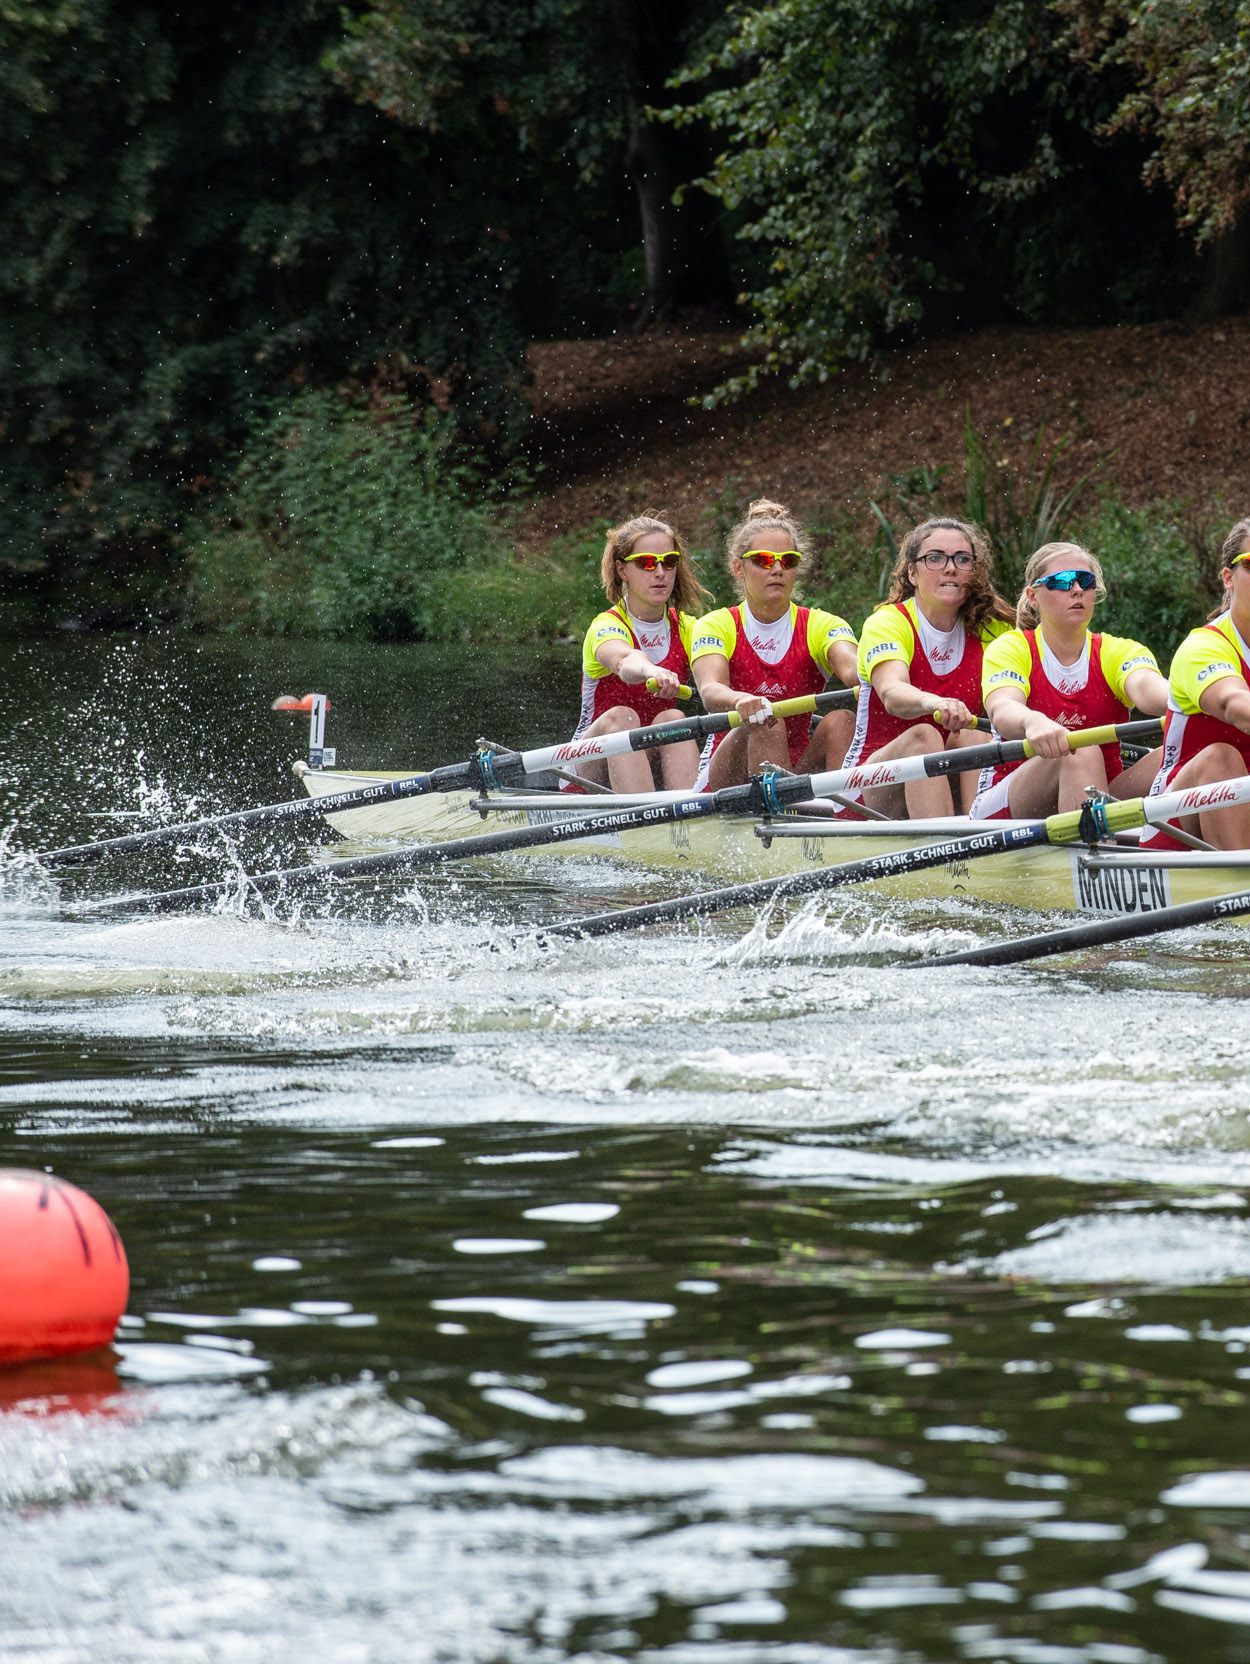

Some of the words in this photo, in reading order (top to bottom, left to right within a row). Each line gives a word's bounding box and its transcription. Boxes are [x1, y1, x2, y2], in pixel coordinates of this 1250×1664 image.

[699, 637, 723, 649] RBL
[872, 642, 898, 655] RBL
[313, 699, 321, 744] 1
[551, 740, 605, 765] Melitta
[843, 765, 900, 792] Melitta
[363, 786, 387, 799] GUT.
[1176, 783, 1240, 813] Melitta
[681, 801, 702, 812] RBL
[552, 823, 589, 836] STARK.
[591, 814, 642, 830] SCHNELL.
[643, 807, 669, 820] GUT.
[1011, 827, 1034, 840] RBL
[871, 854, 912, 870] STARK.
[914, 842, 969, 862] SCHNELL.
[970, 835, 998, 850] GUT.
[1077, 858, 1168, 913] MINDEN
